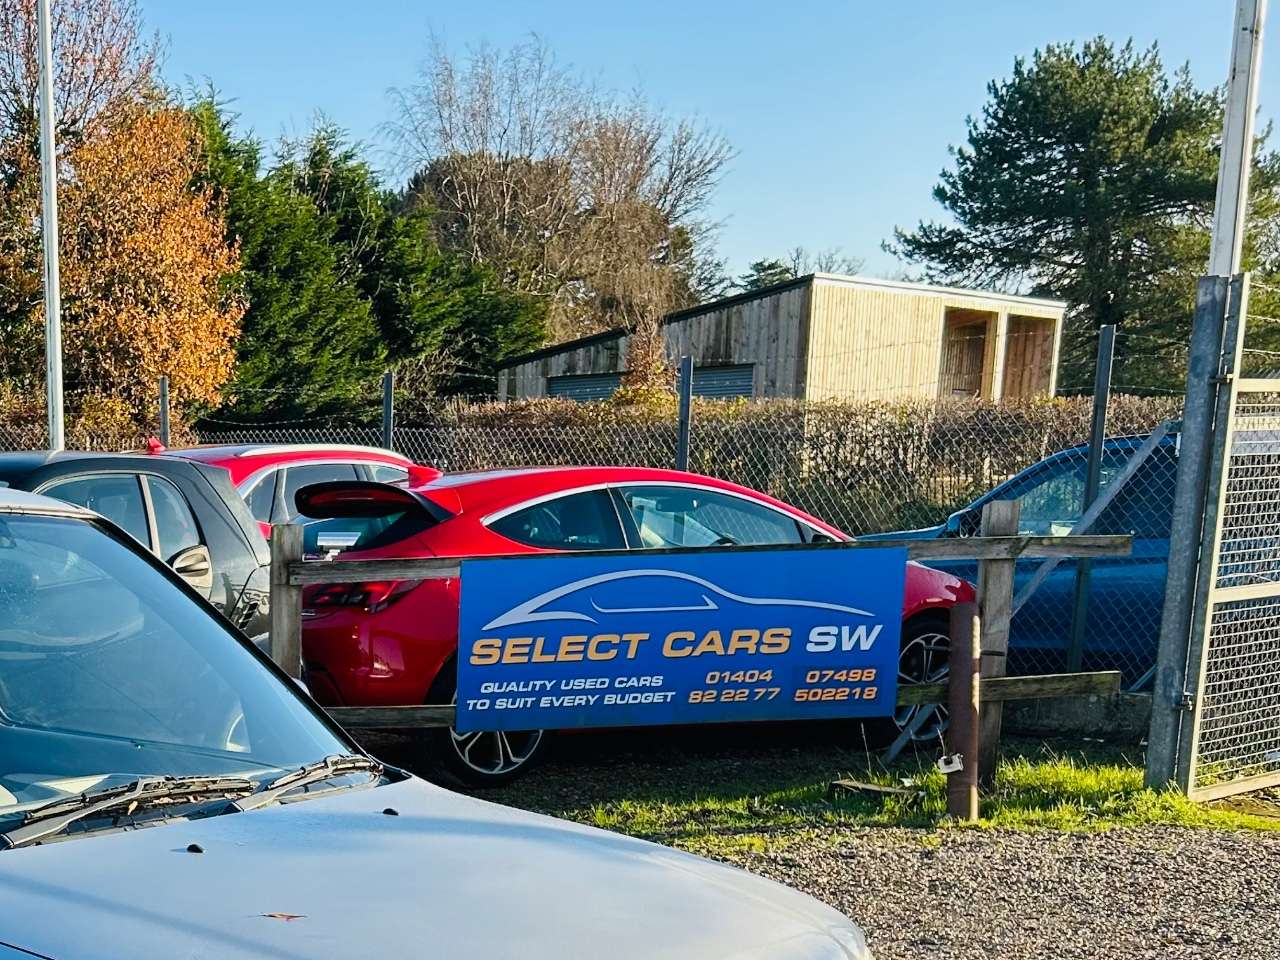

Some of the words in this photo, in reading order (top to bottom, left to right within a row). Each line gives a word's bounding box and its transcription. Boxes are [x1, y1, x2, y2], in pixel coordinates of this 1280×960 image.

[469, 632, 650, 666] SELECT
[662, 627, 792, 657] CARS
[805, 624, 884, 653] SW
[480, 679, 556, 694] QUALITY
[560, 677, 609, 691] USED
[614, 675, 664, 688] CARS
[705, 669, 773, 685] 01404
[805, 668, 877, 684] 07498
[466, 699, 490, 711] TO
[494, 697, 536, 710] SUIT
[539, 694, 600, 708] EVERY
[603, 691, 676, 705] BUDGET
[793, 687, 878, 702] 502218
